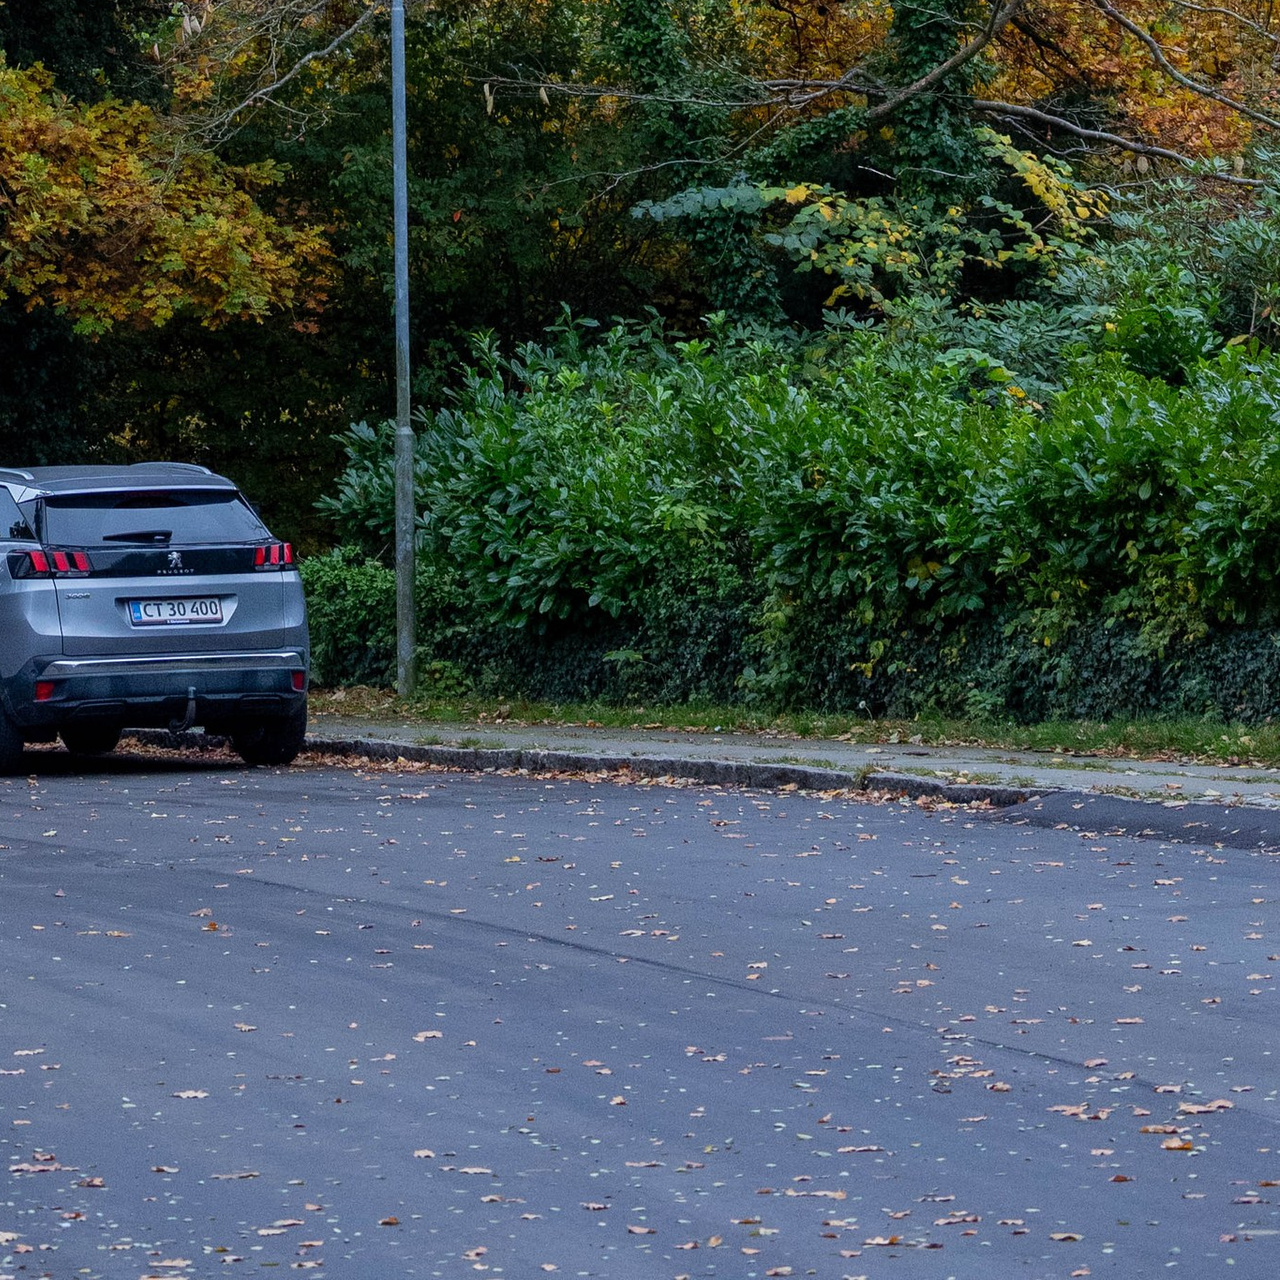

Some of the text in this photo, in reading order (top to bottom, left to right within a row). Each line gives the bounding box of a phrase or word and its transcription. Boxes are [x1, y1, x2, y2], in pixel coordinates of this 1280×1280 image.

[143, 600, 218, 617] CT 30 400
